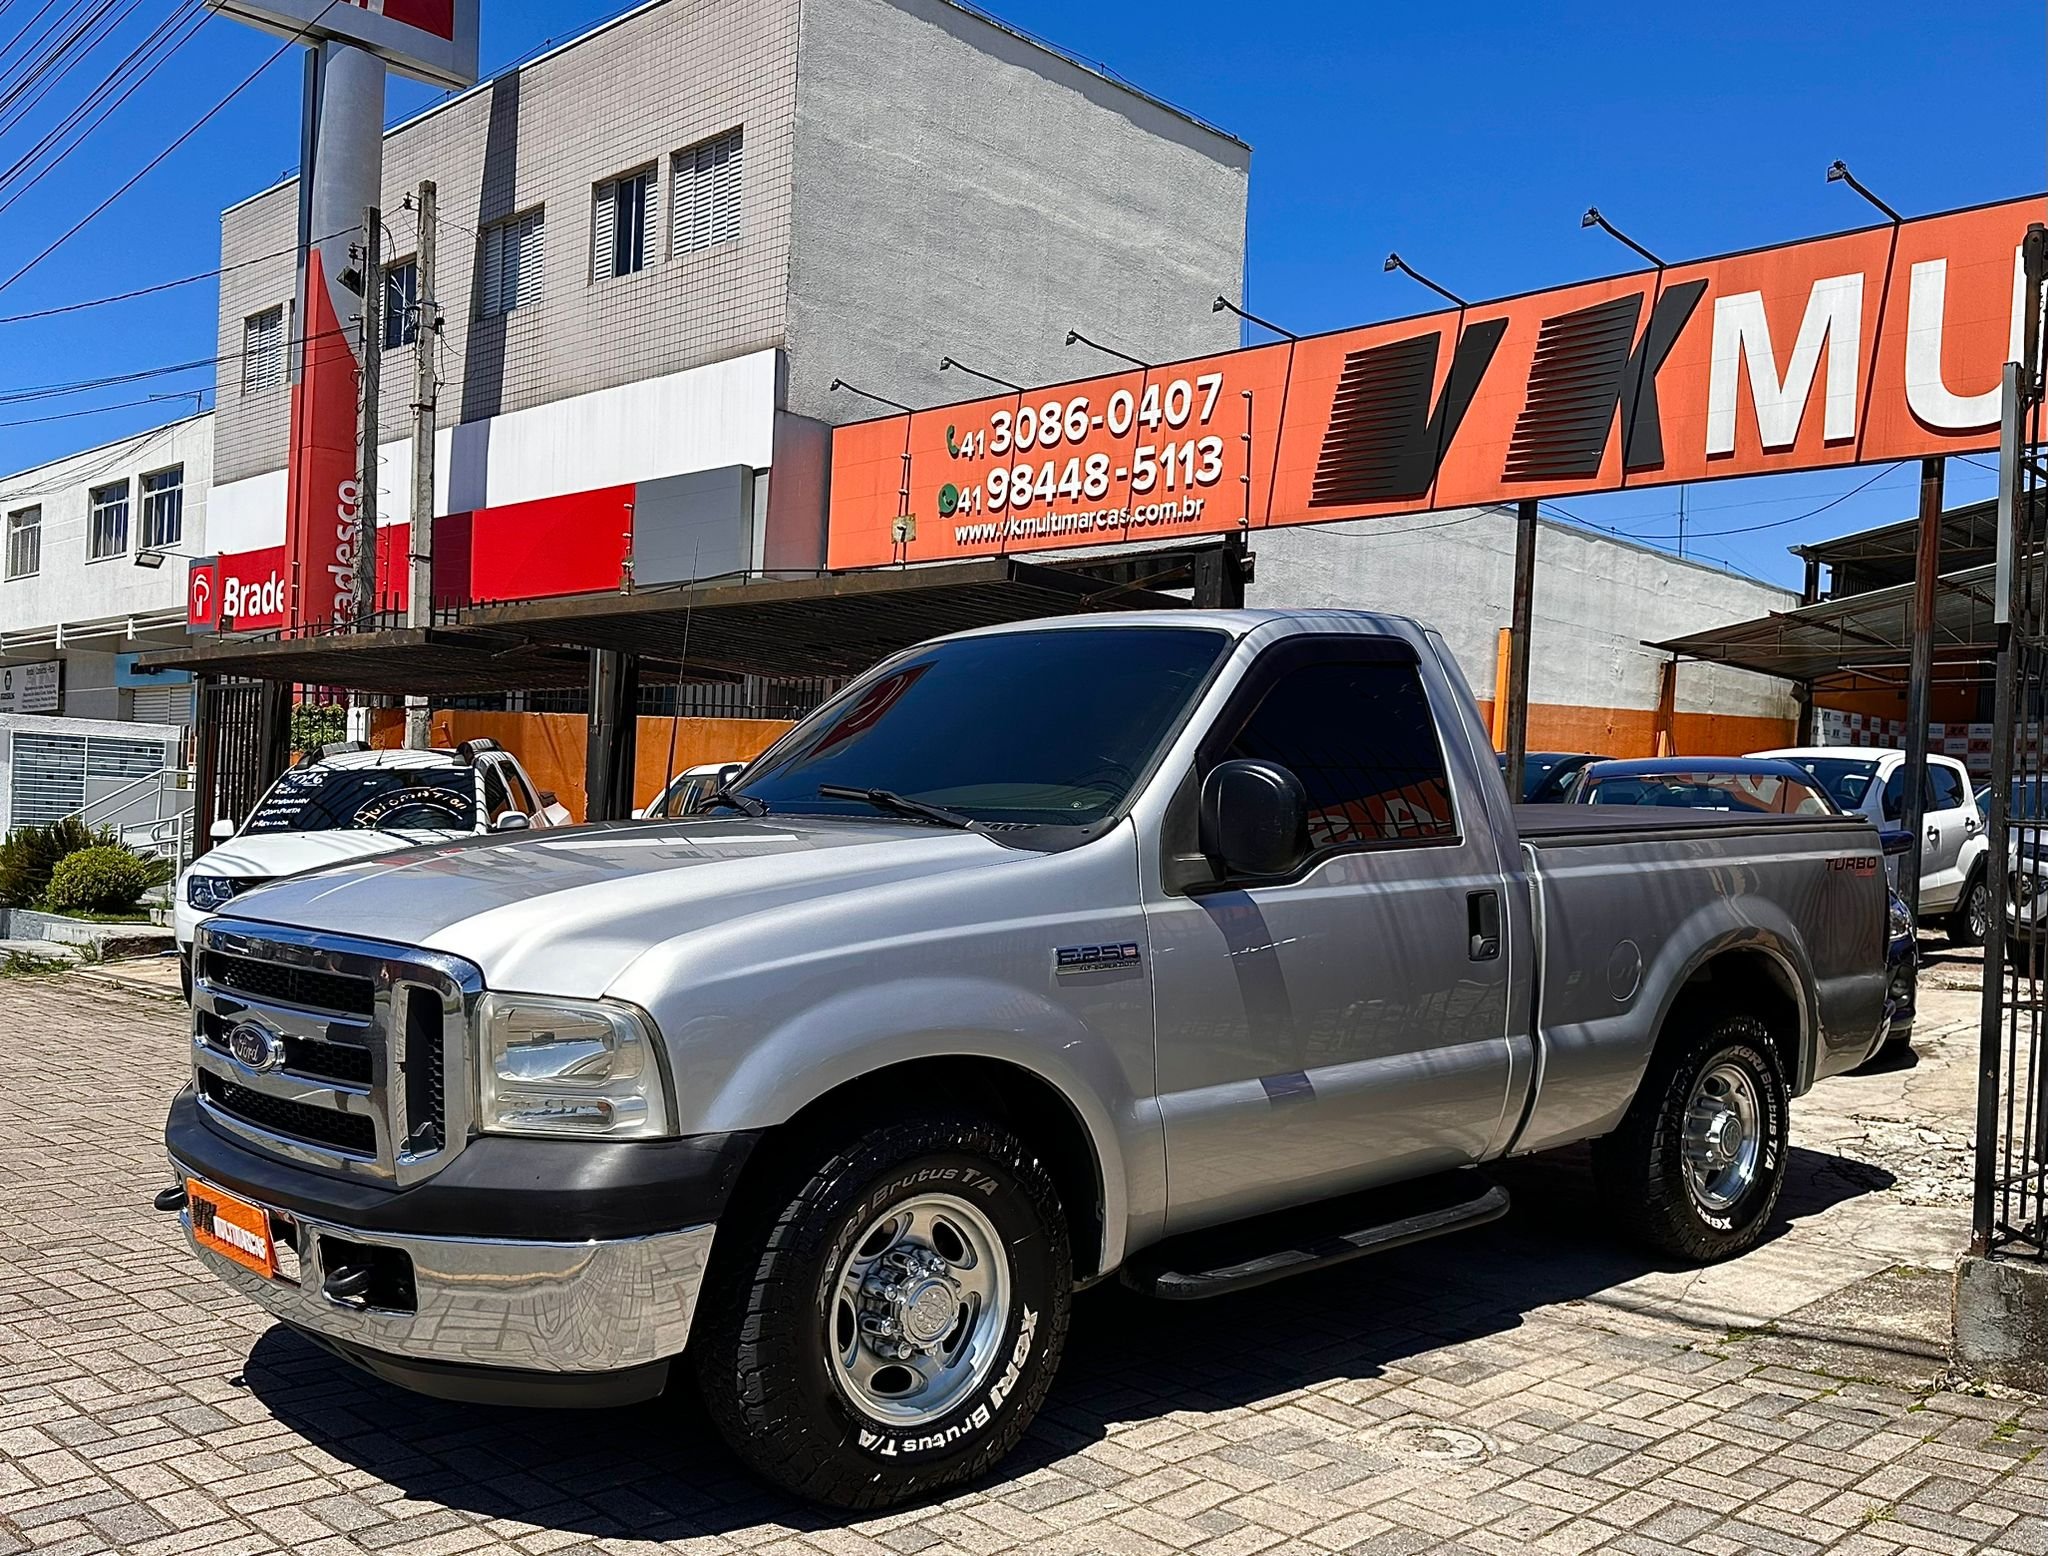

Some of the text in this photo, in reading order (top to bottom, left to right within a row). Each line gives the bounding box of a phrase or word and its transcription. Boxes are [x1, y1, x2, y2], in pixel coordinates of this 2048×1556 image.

[959, 373, 1223, 459] 41 3086-0407
[956, 436, 1223, 513] 41 98448-5113
[955, 496, 1204, 544] www.vkmultimarcas.com.br
[1825, 856, 1877, 871] TURBO
[236, 1032, 260, 1062] Ford
[1760, 1071, 1777, 1136] Brutus
[1764, 1140, 1778, 1170] T/A
[872, 1168, 958, 1209] Brutus
[961, 1167, 999, 1197] T/A
[858, 1429, 898, 1457] T/A
[902, 1403, 991, 1453] Brutus
